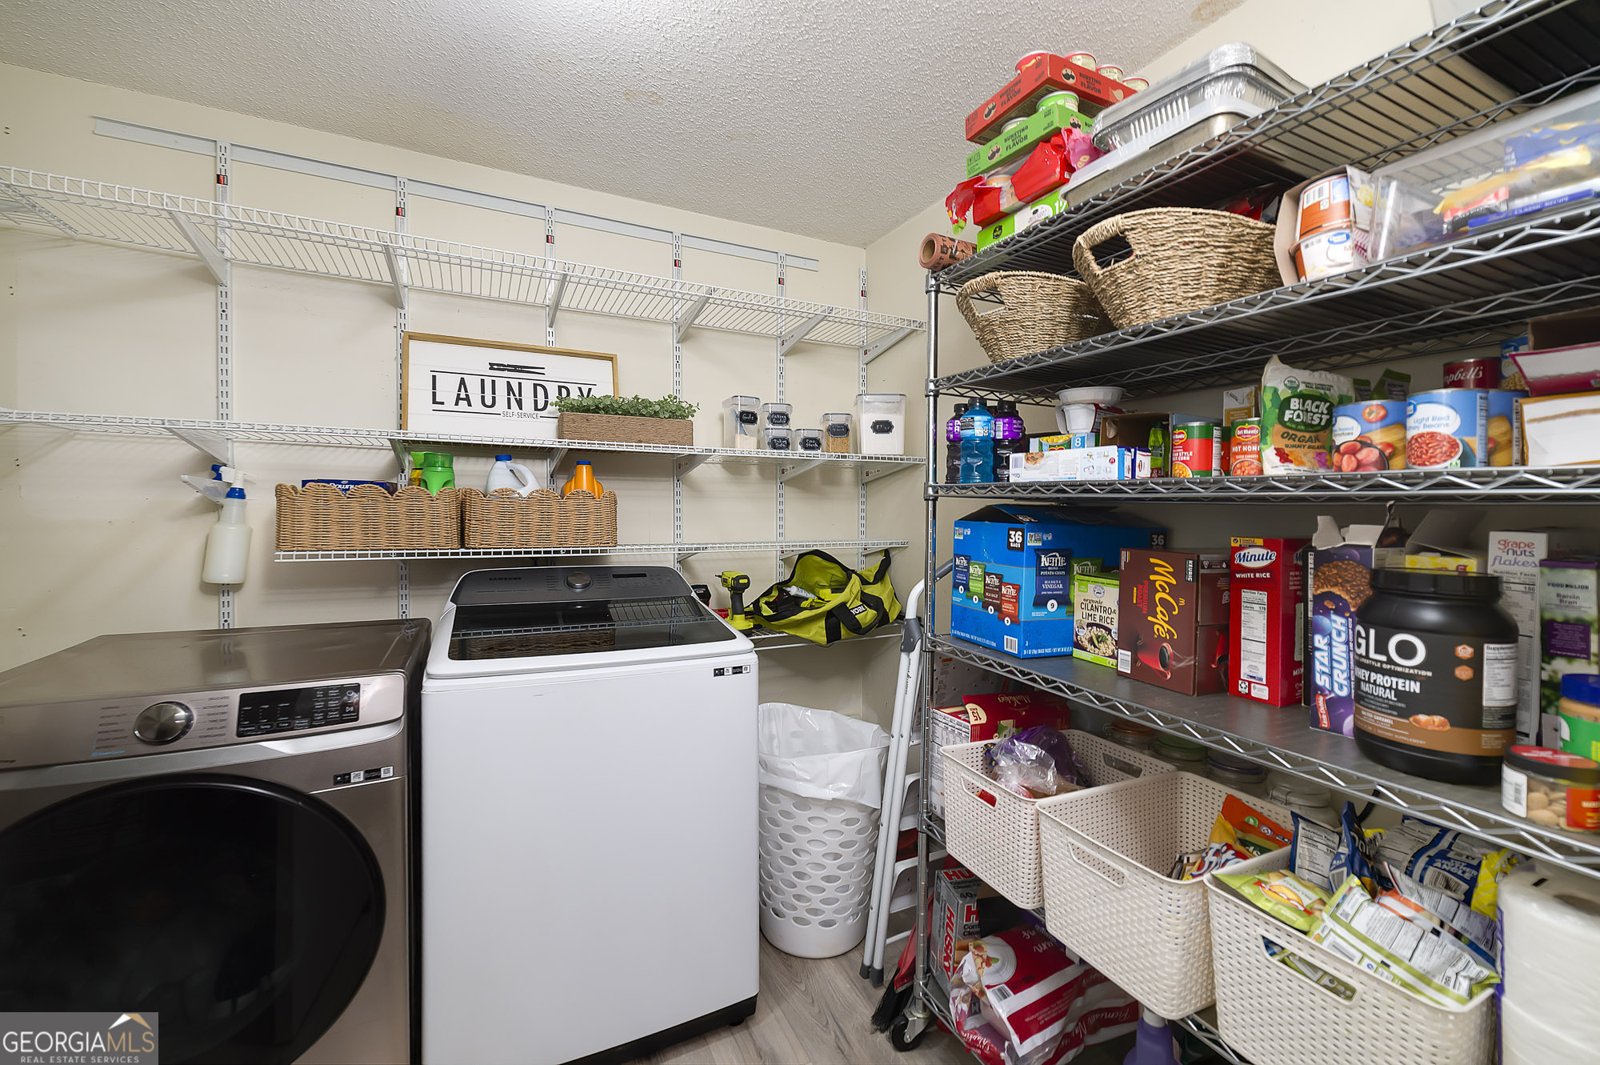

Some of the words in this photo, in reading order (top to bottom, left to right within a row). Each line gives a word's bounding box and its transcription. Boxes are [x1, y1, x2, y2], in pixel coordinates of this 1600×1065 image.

[1004, 125, 1028, 142] BURSTING
[1006, 135, 1028, 151] FLAVOR
[1290, 397, 1330, 414] BLACK
[502, 410, 540, 419] SELF-SERVICE
[1075, 438, 1082, 446] 8
[1010, 530, 1022, 543] 36
[1152, 534, 1165, 546] 36
[1498, 539, 1536, 551] grape
[1235, 550, 1276, 563] Minute
[1491, 556, 1540, 568] flakes
[1080, 602, 1112, 615] CILANTRO
[1082, 612, 1098, 622] LIME
[1099, 615, 1114, 625] RICE
[1314, 634, 1331, 690] STAR
[1332, 614, 1348, 697] CRUNCH
[1382, 663, 1432, 677] OPTIMIZATION
[1370, 672, 1420, 693] PROTEIN
[1360, 683, 1398, 701] NATURAL
